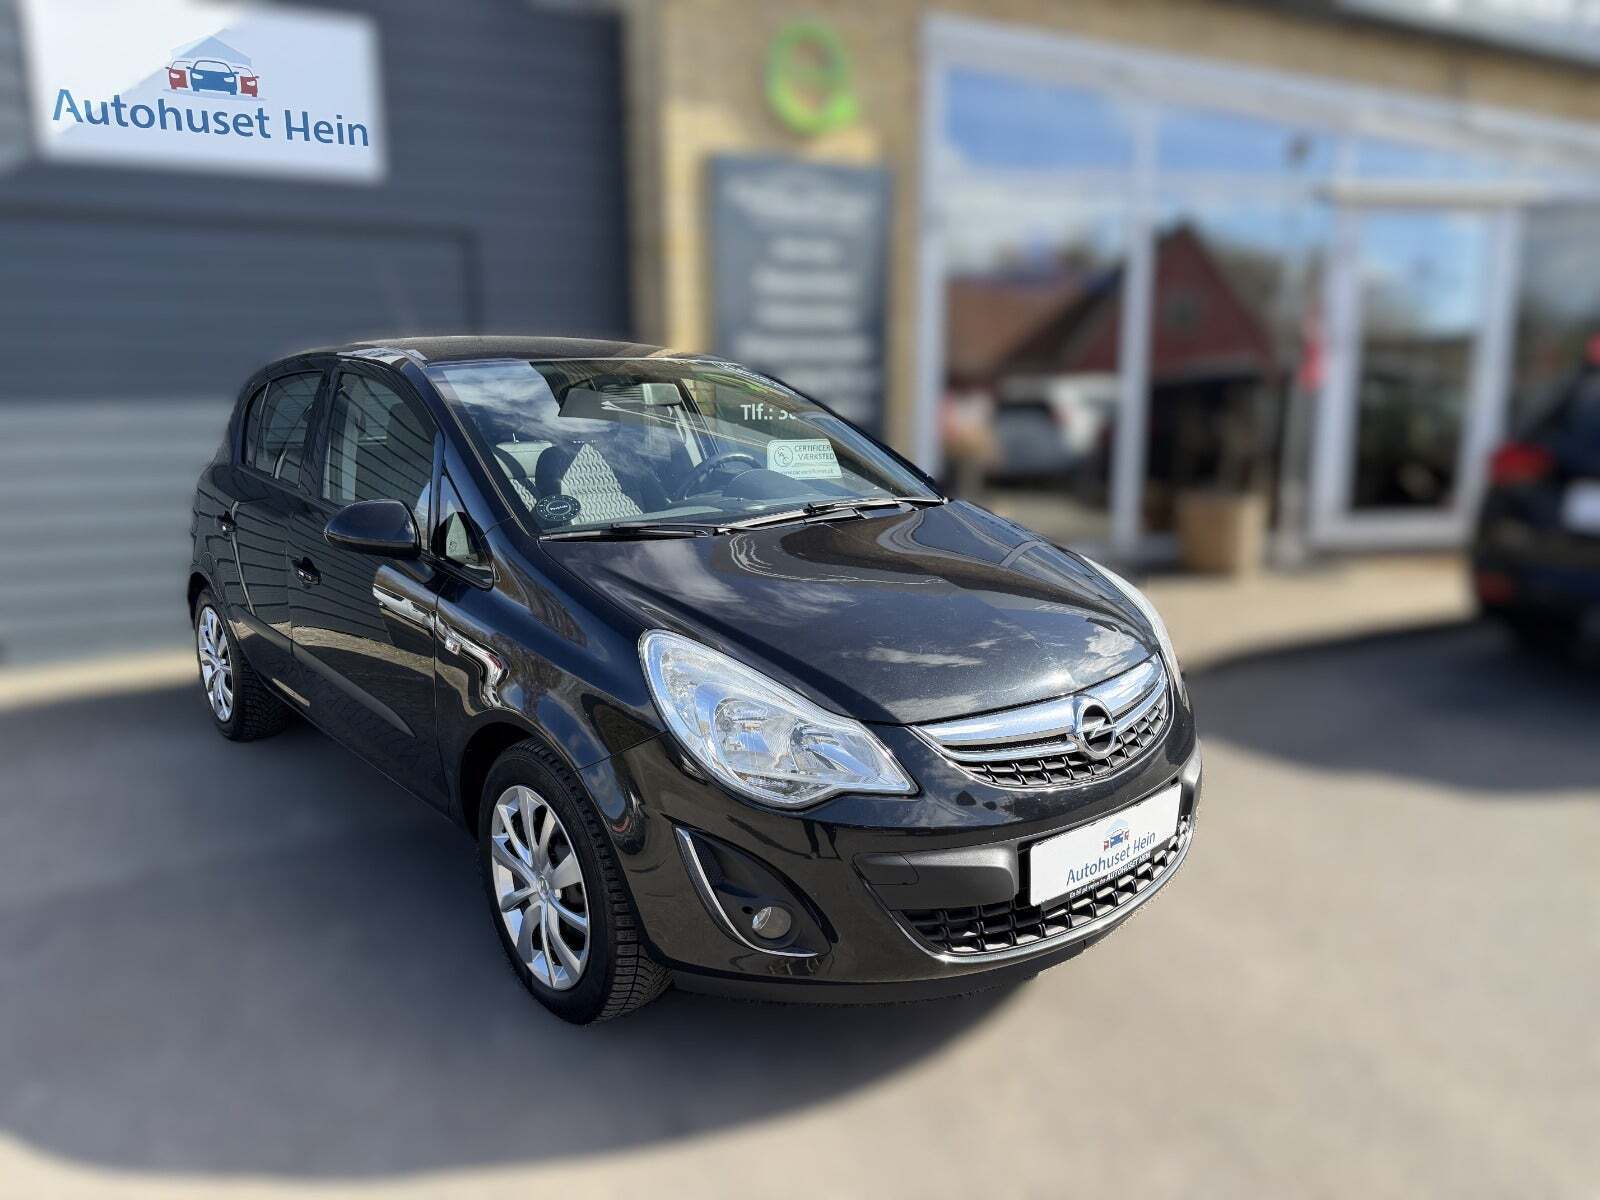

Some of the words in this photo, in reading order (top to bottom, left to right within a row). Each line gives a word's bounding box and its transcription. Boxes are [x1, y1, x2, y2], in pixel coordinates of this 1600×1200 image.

[53, 88, 271, 139] Autohuset
[284, 109, 369, 146] Hein
[740, 403, 773, 420] Tlf.:
[1066, 844, 1130, 886] Autohuset
[1133, 832, 1155, 854] Hein
